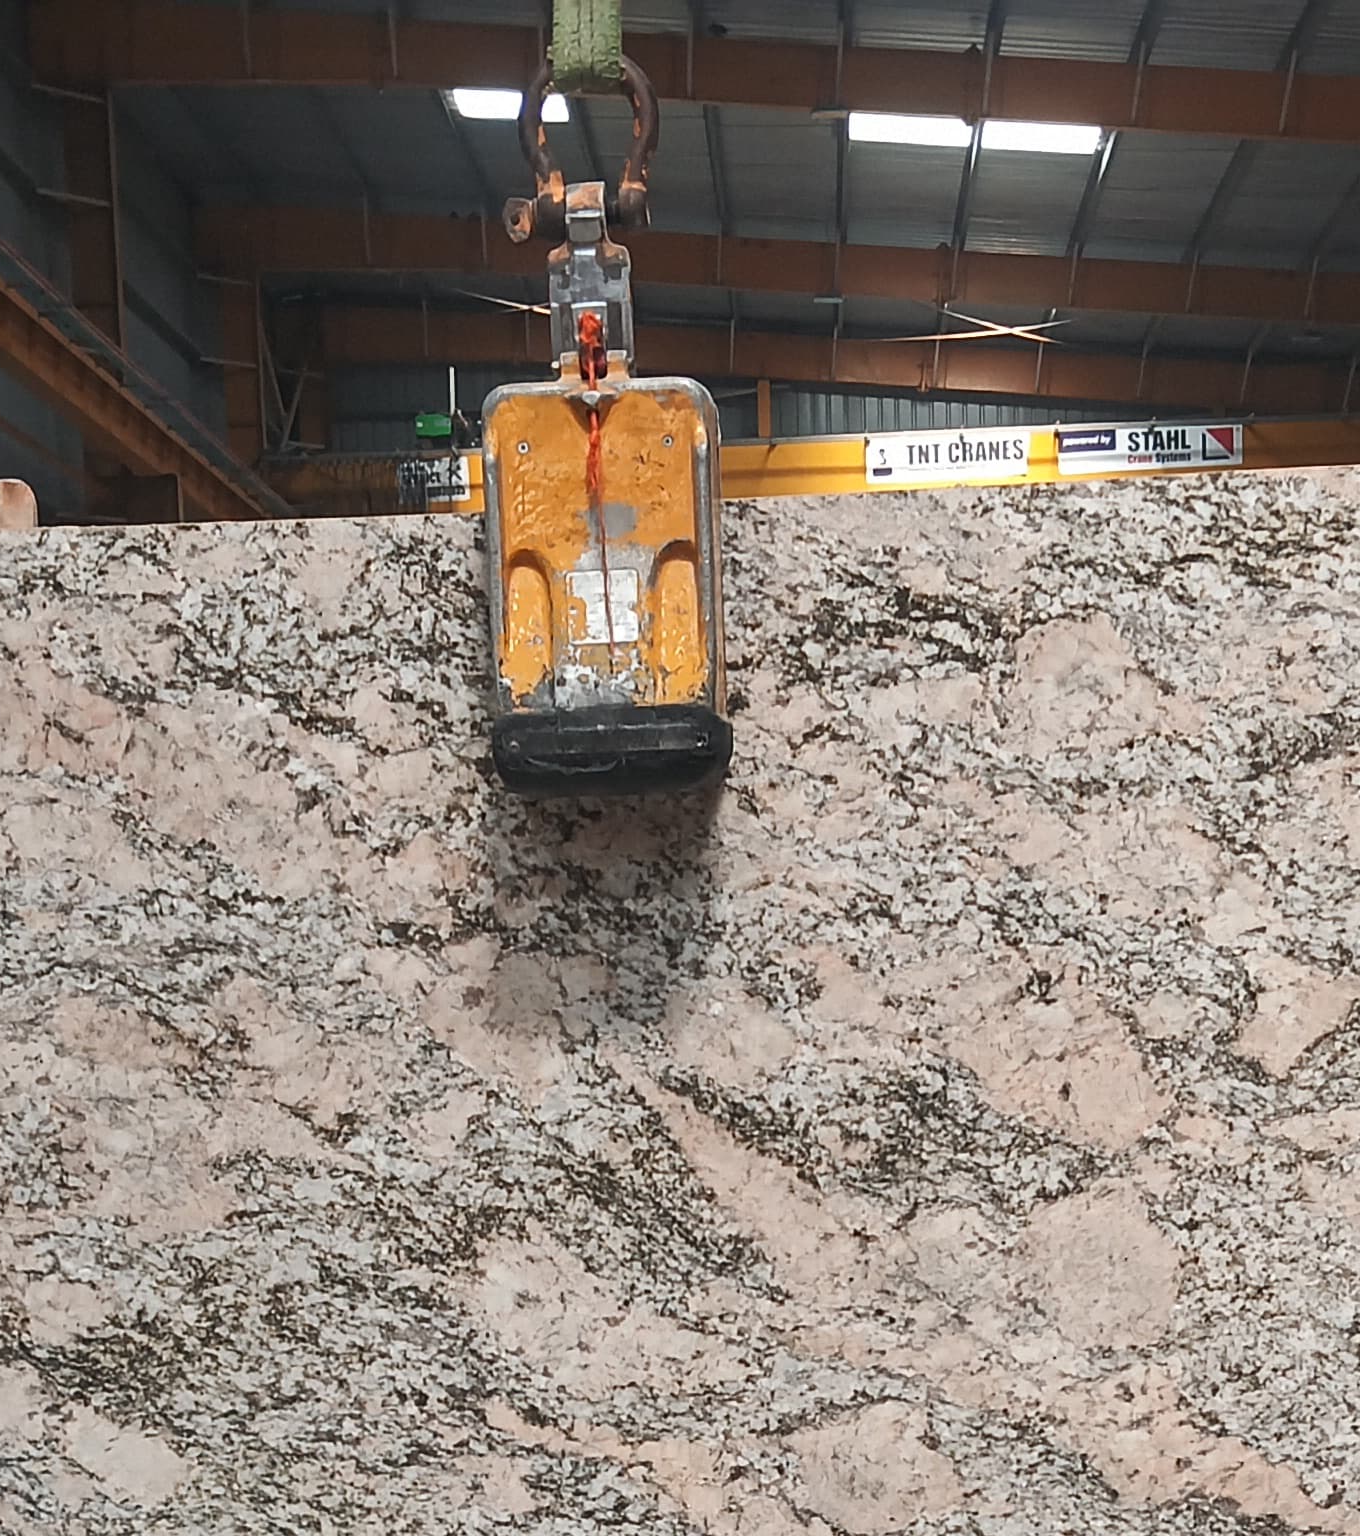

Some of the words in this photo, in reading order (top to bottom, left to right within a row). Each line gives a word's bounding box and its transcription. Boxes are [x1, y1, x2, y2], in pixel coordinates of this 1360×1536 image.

[906, 443, 941, 465] TNT
[948, 439, 1024, 464] CRANES
[1127, 429, 1192, 452] STAHL
